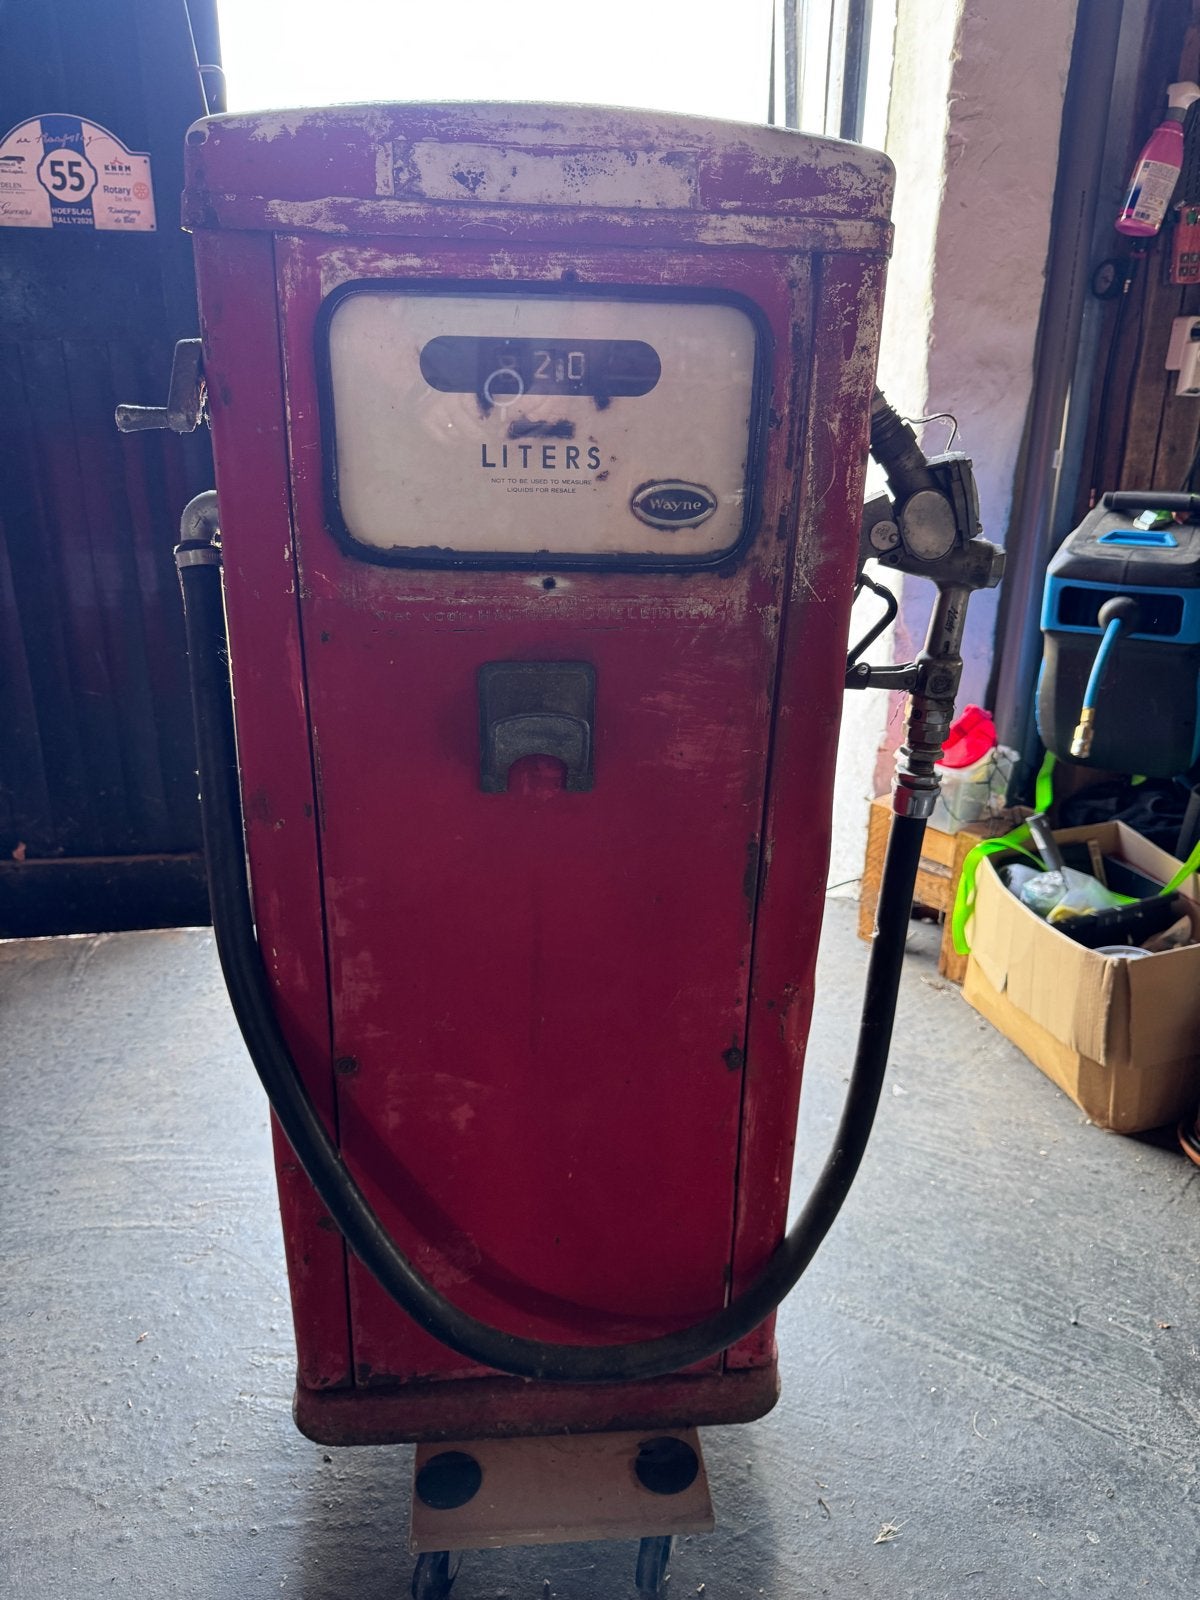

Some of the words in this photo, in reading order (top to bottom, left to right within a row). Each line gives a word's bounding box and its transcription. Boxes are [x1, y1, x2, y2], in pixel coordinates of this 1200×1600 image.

[104, 164, 131, 172] KNRM
[50, 160, 85, 191] 55
[103, 185, 131, 196] Rotary
[52, 207, 92, 216] HOEFSLAG
[482, 443, 600, 470] LITERS
[649, 498, 702, 512] Wayne
